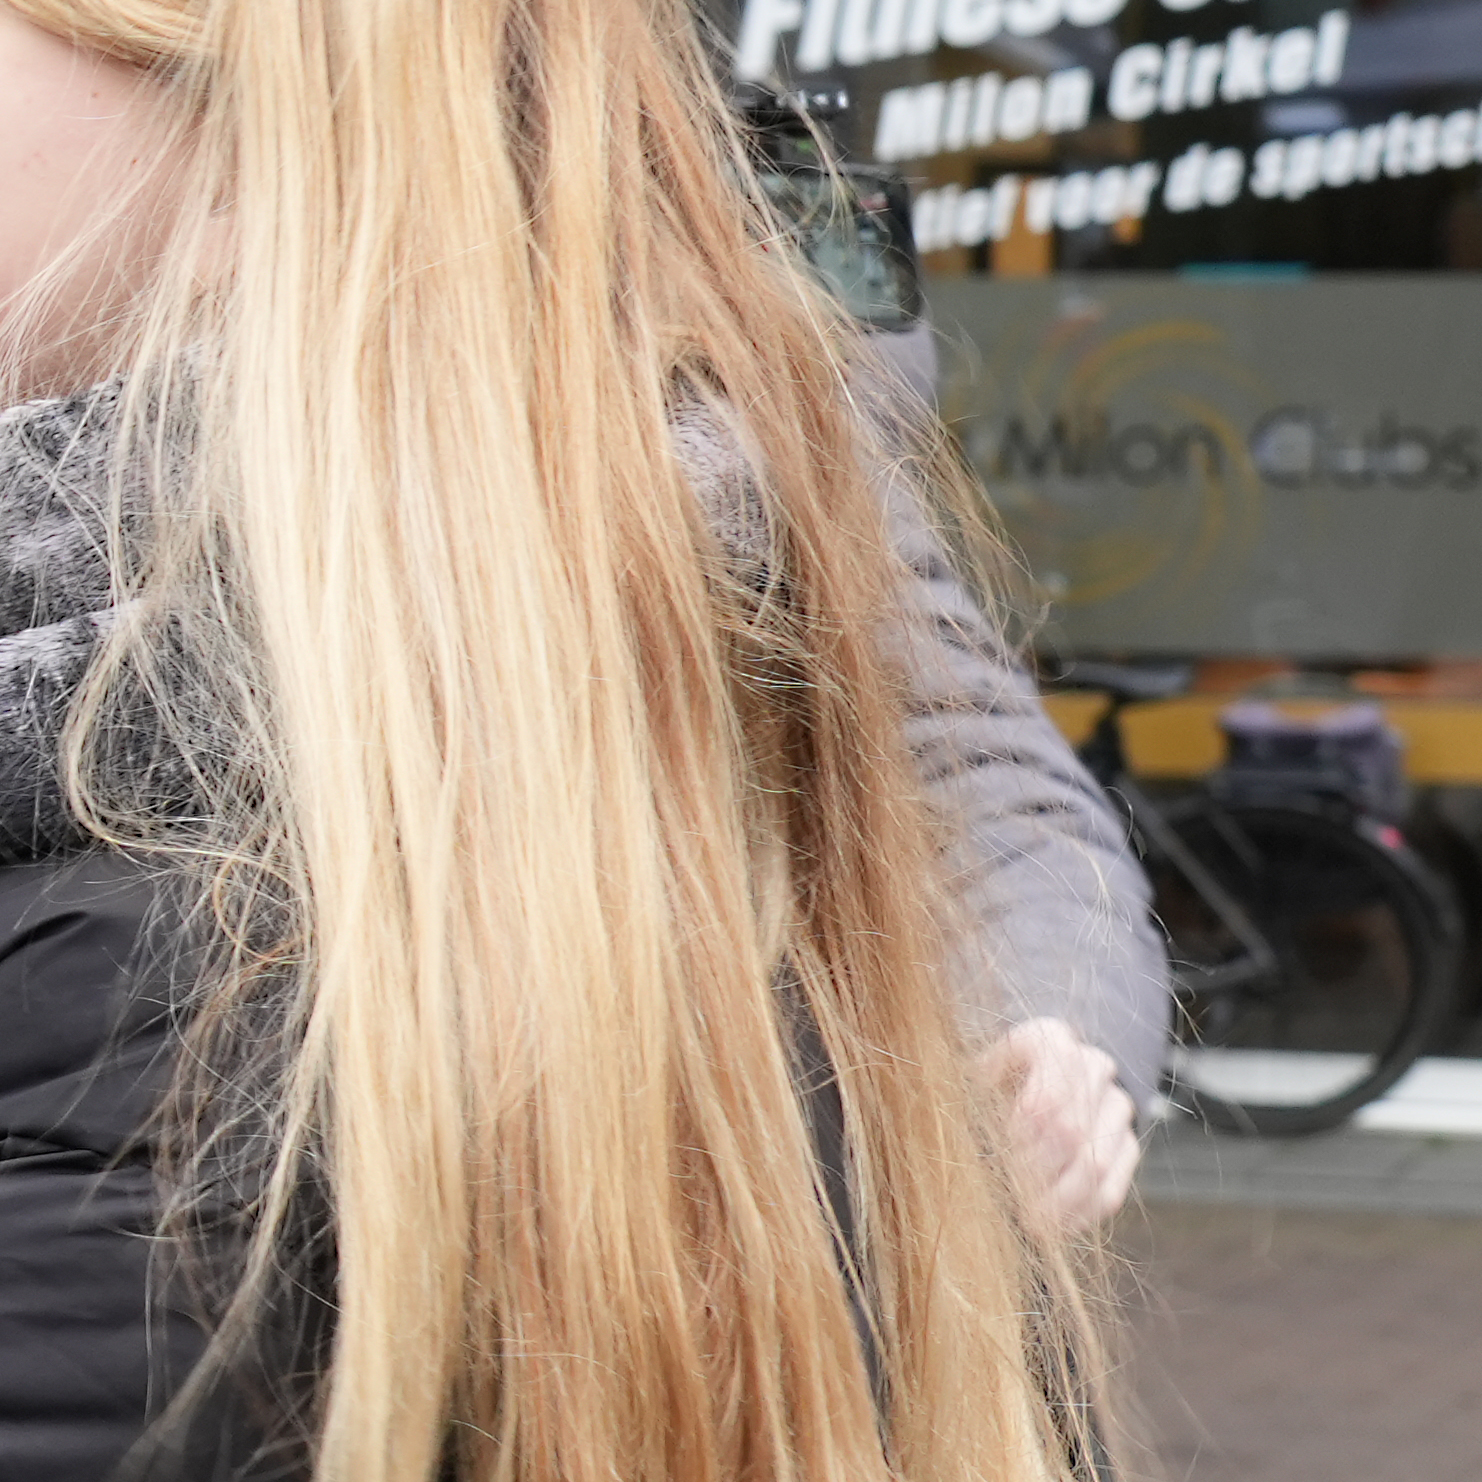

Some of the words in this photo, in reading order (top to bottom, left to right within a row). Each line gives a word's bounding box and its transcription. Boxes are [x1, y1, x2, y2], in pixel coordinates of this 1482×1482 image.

[874, 65, 1096, 163] Milon
[1108, 9, 1352, 122] Cirkel
[1023, 160, 1161, 235] voor
[1163, 140, 1246, 214] de
[1249, 102, 1482, 202] sportsc
[995, 410, 1226, 488] Milon
